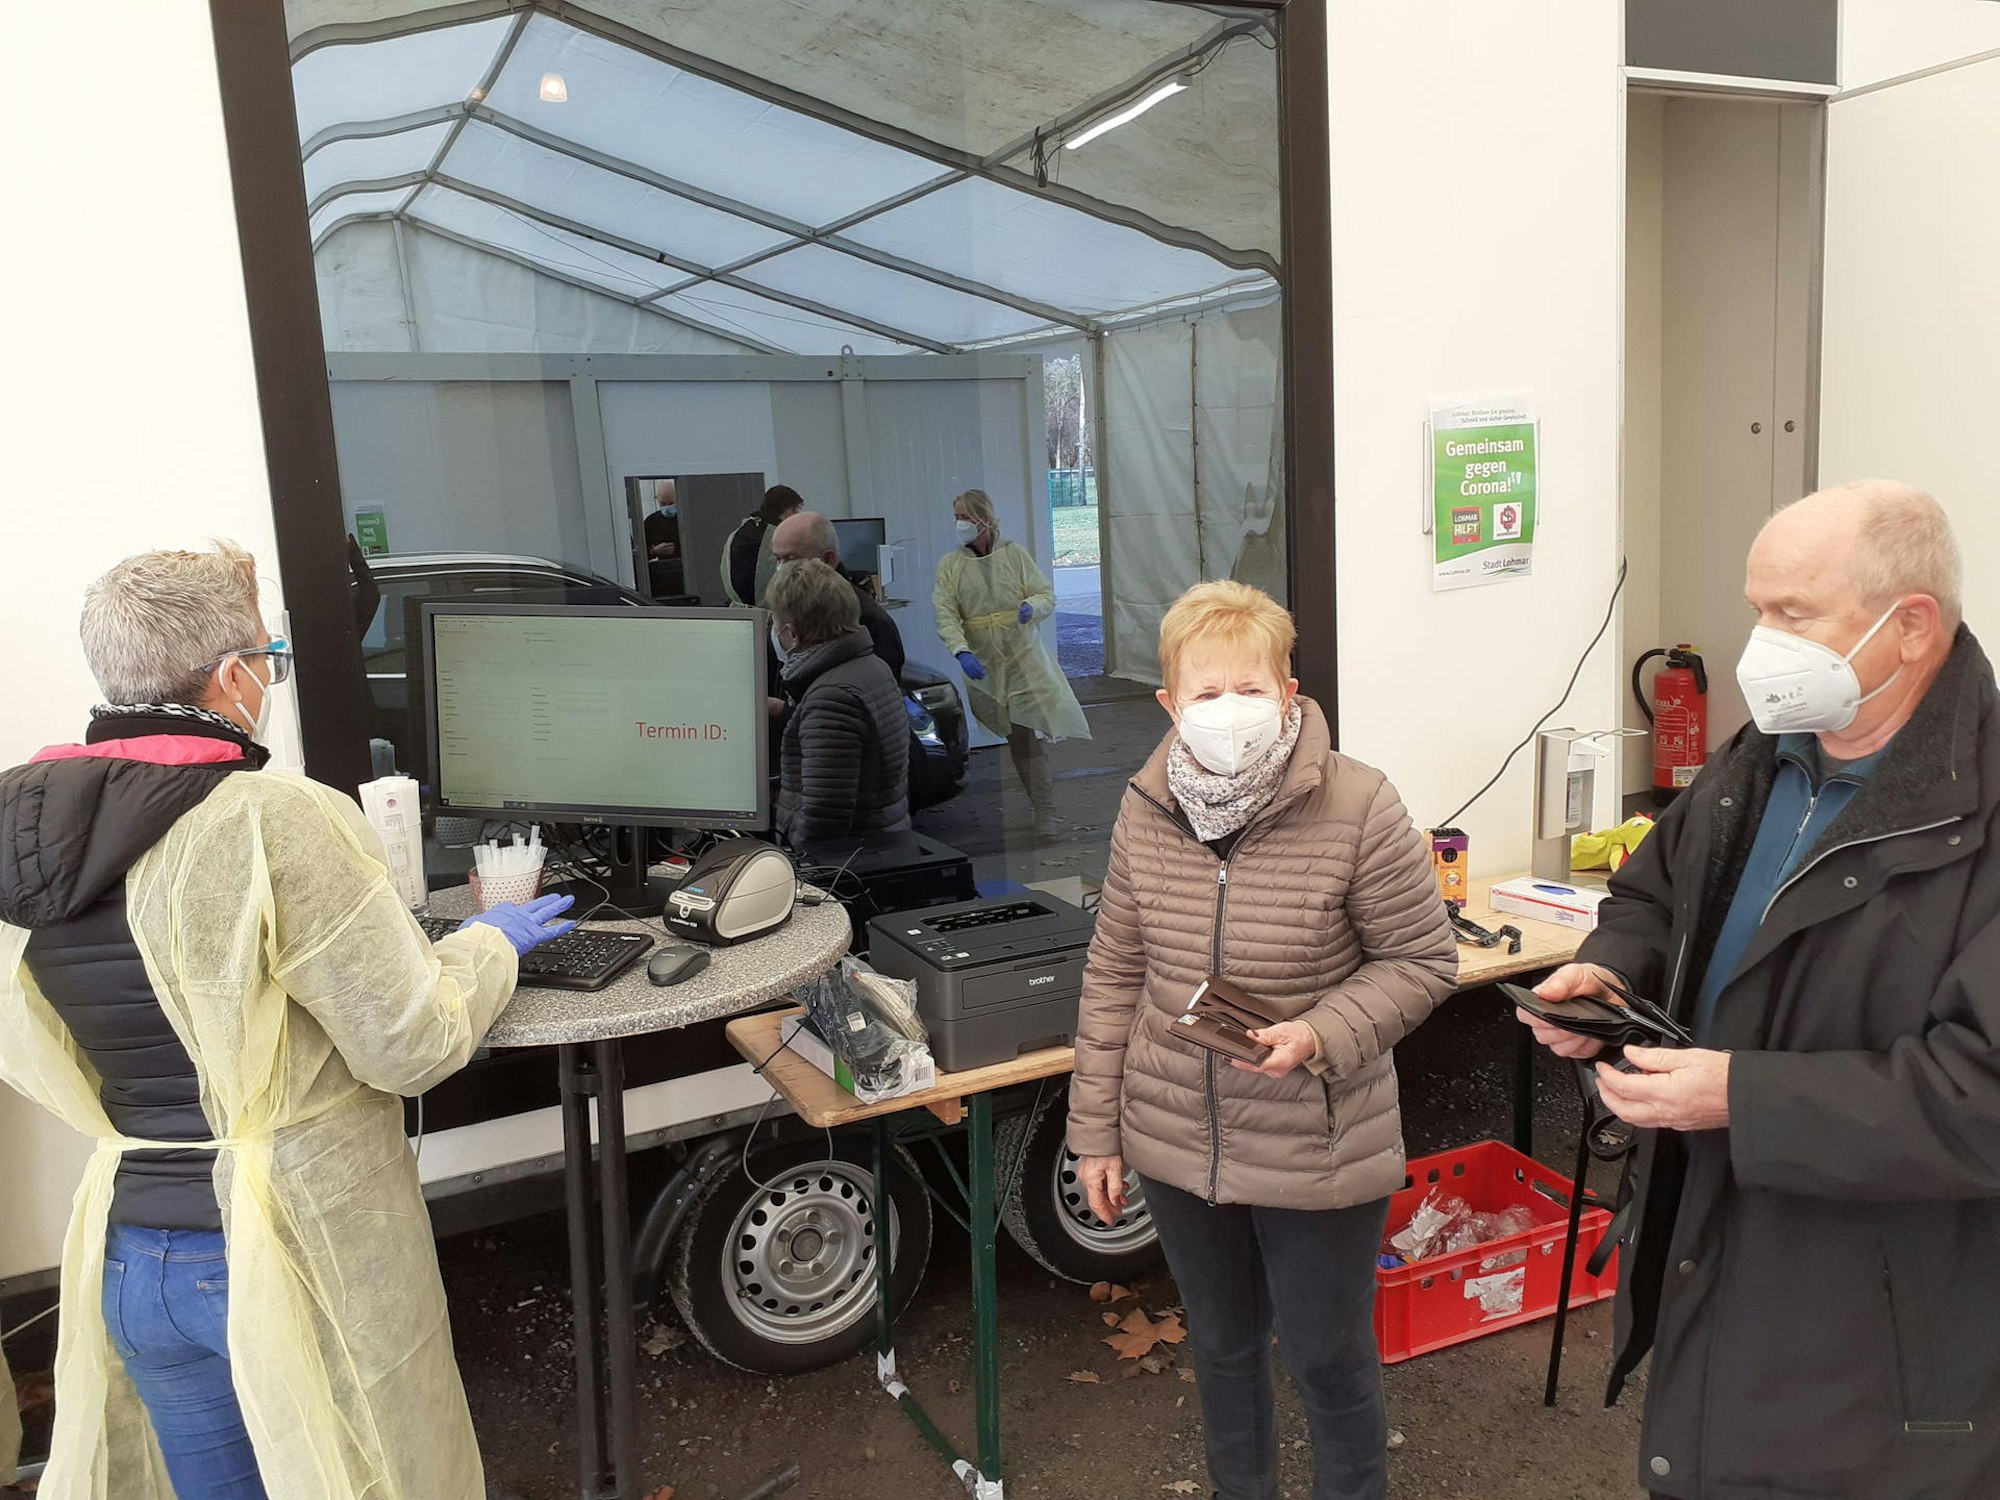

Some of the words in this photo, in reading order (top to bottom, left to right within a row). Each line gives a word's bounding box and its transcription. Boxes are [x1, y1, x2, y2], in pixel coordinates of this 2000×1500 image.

[1445, 438, 1524, 456] Gemeinsam
[1465, 460, 1507, 480] gegen
[1460, 476, 1512, 496] Corona!
[1454, 523, 1479, 536] HILFT
[1482, 560, 1502, 570] Stadt
[1502, 557, 1530, 568] Lohmar
[635, 721, 698, 740] Termin
[704, 723, 727, 741] ID:
[1028, 974, 1056, 986] brother
